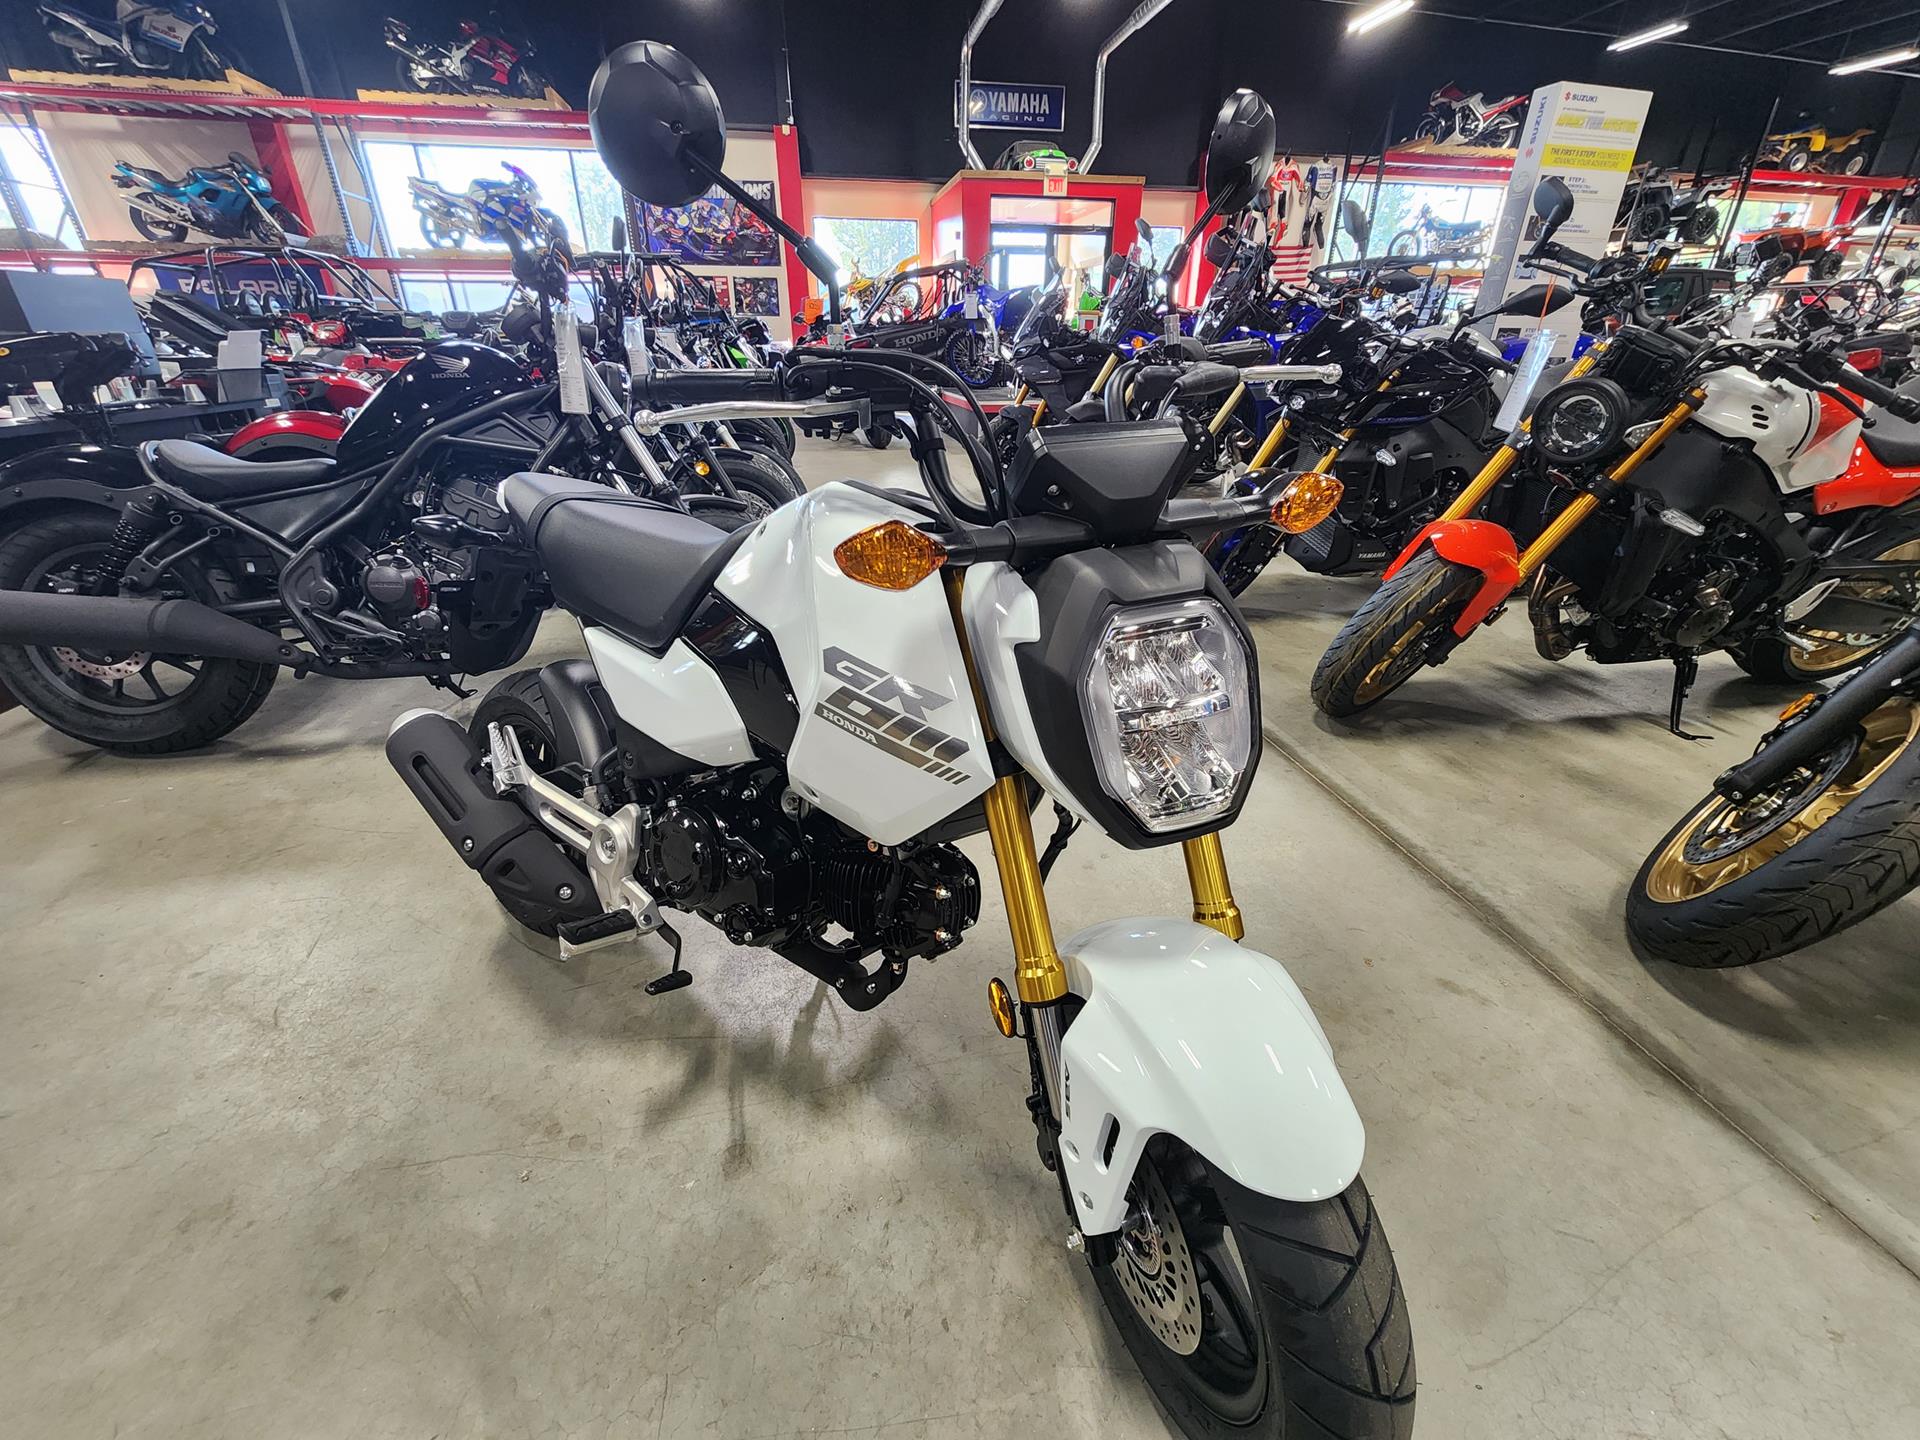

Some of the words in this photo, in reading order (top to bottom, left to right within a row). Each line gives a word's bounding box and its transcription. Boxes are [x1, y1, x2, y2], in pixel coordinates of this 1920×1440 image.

[988, 91, 1050, 114] YAMAHA
[1572, 93, 1598, 103] SUZUKI
[976, 113, 1045, 122] RACING
[1529, 96, 1548, 145] SUZUKI
[1560, 148, 1575, 157] FIRST
[1579, 150, 1597, 158] STEPS
[1048, 177, 1064, 193] EXIT
[895, 328, 947, 348] HONDA
[431, 372, 470, 380] HONDA
[1358, 551, 1386, 559] YAMAHA
[821, 708, 879, 745] HONDA
